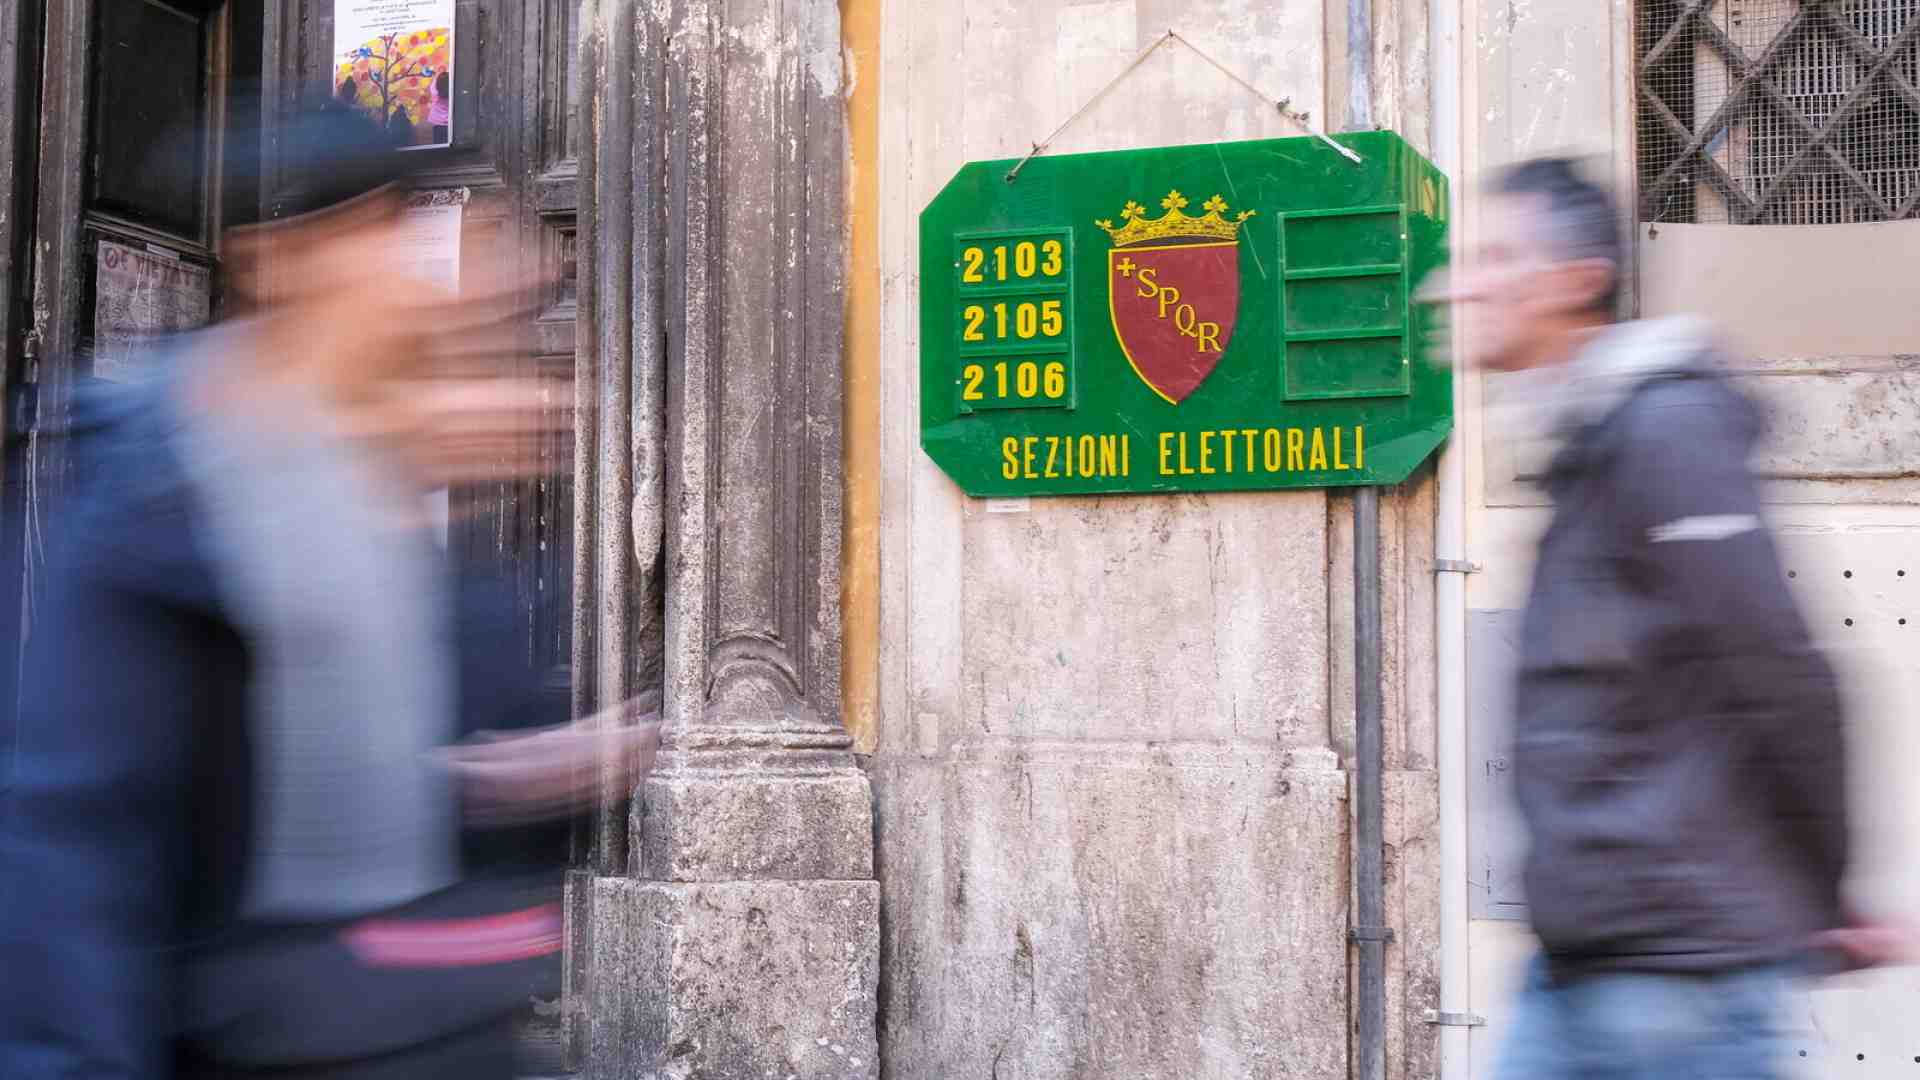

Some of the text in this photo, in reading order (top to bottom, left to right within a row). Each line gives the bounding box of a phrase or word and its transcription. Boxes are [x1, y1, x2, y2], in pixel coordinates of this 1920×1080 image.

[963, 239, 1063, 284] 2103
[963, 300, 1063, 342] 2105
[1136, 267, 1222, 353] SPQR
[963, 361, 1065, 401] 2106
[1002, 425, 1365, 480] SEZIONI ELETTORALI
